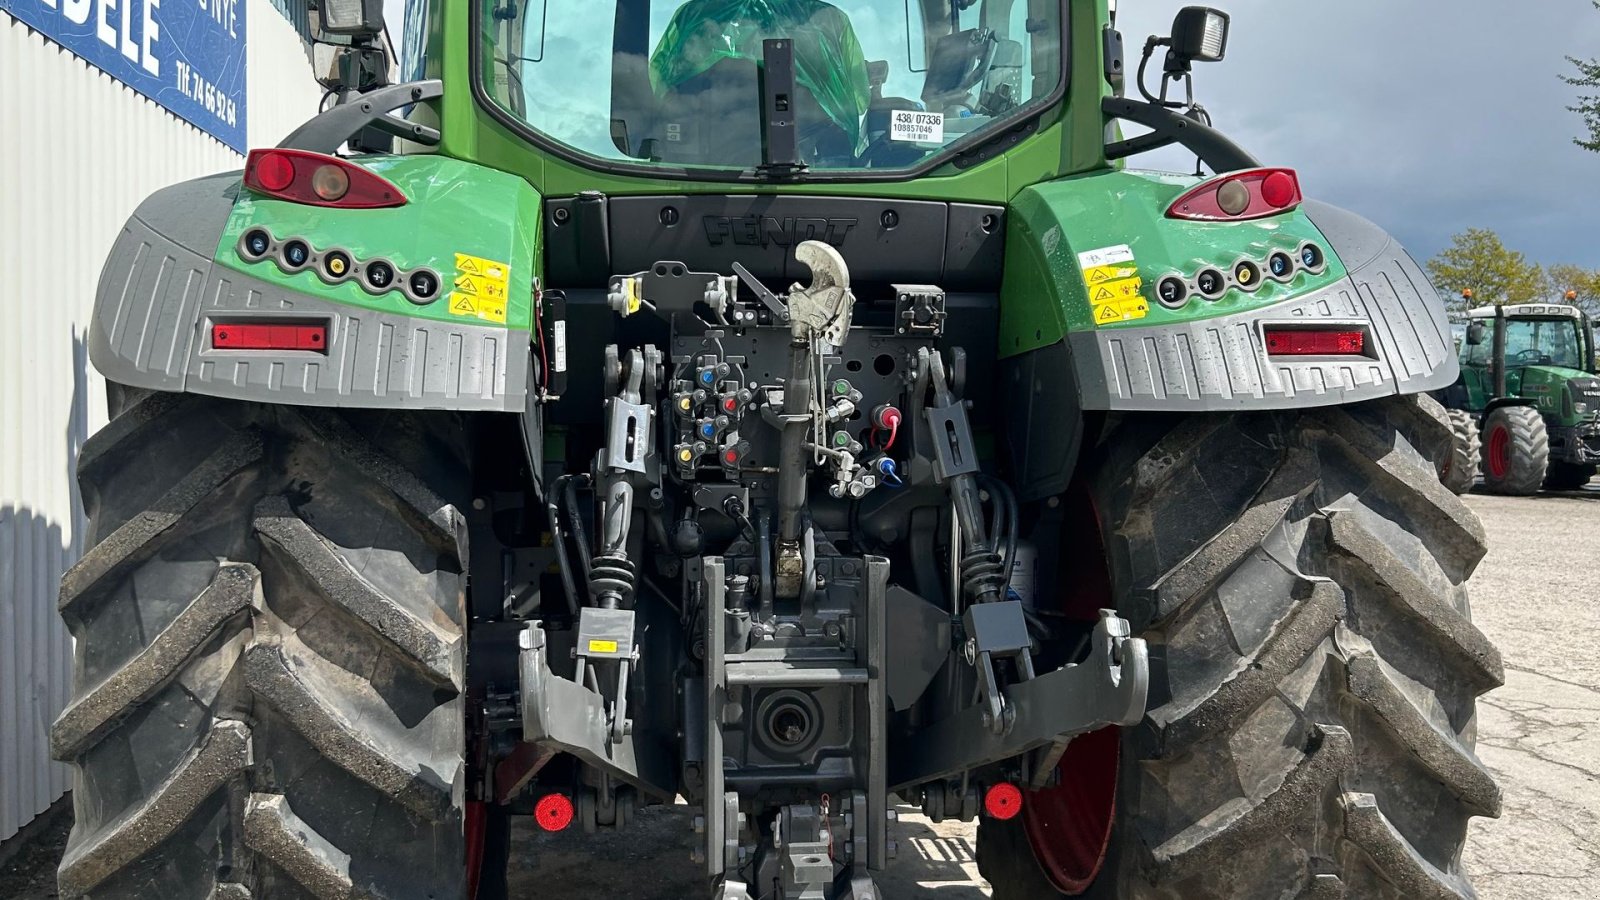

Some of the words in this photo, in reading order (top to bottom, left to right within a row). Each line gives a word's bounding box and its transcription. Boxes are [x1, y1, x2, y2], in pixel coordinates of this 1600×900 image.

[176, 60, 191, 97] Tlf.
[193, 72, 204, 105] 74
[205, 82, 216, 113] 66
[217, 90, 226, 121] 92
[227, 98, 236, 128] 64
[703, 216, 858, 246] FENDT
